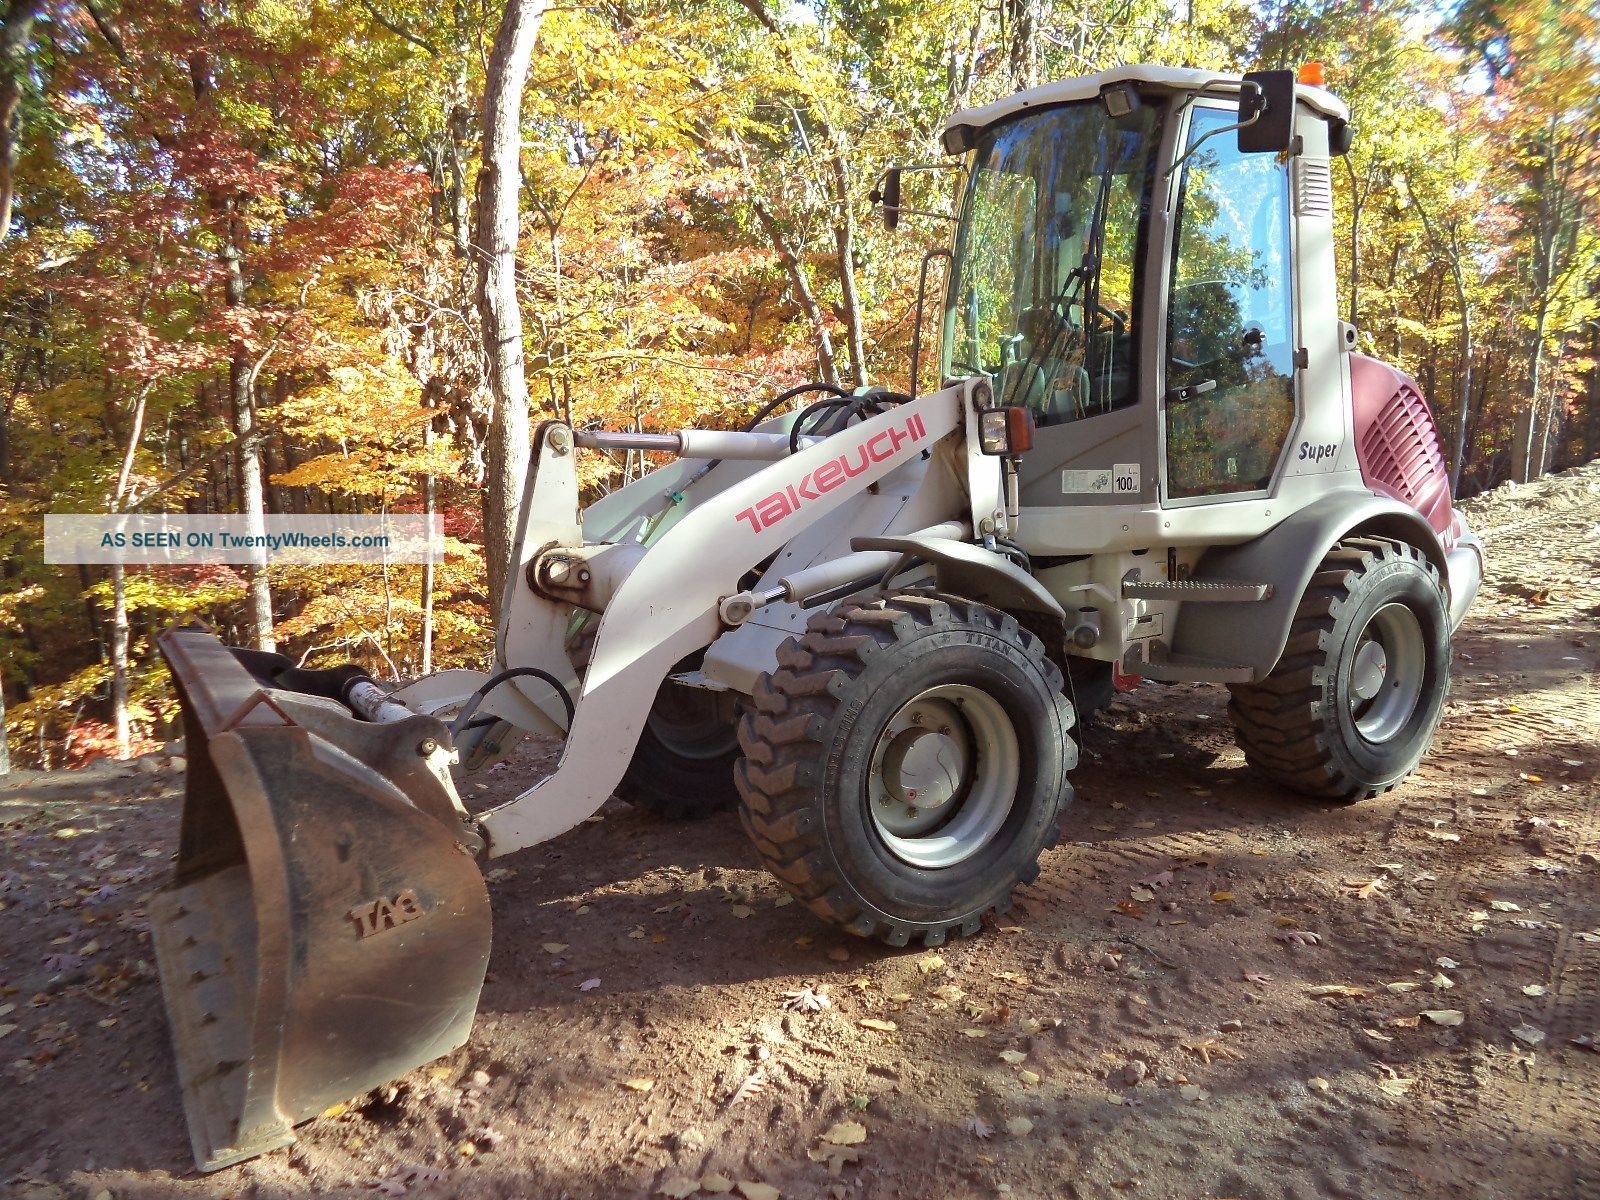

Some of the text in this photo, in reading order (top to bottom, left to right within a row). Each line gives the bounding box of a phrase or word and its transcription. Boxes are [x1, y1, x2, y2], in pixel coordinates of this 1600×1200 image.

[1298, 441, 1337, 464] Super
[735, 412, 927, 534] TAKEUCHI
[1116, 477, 1133, 491] 100
[965, 633, 1012, 656] TITAN
[345, 889, 424, 940] TAG
